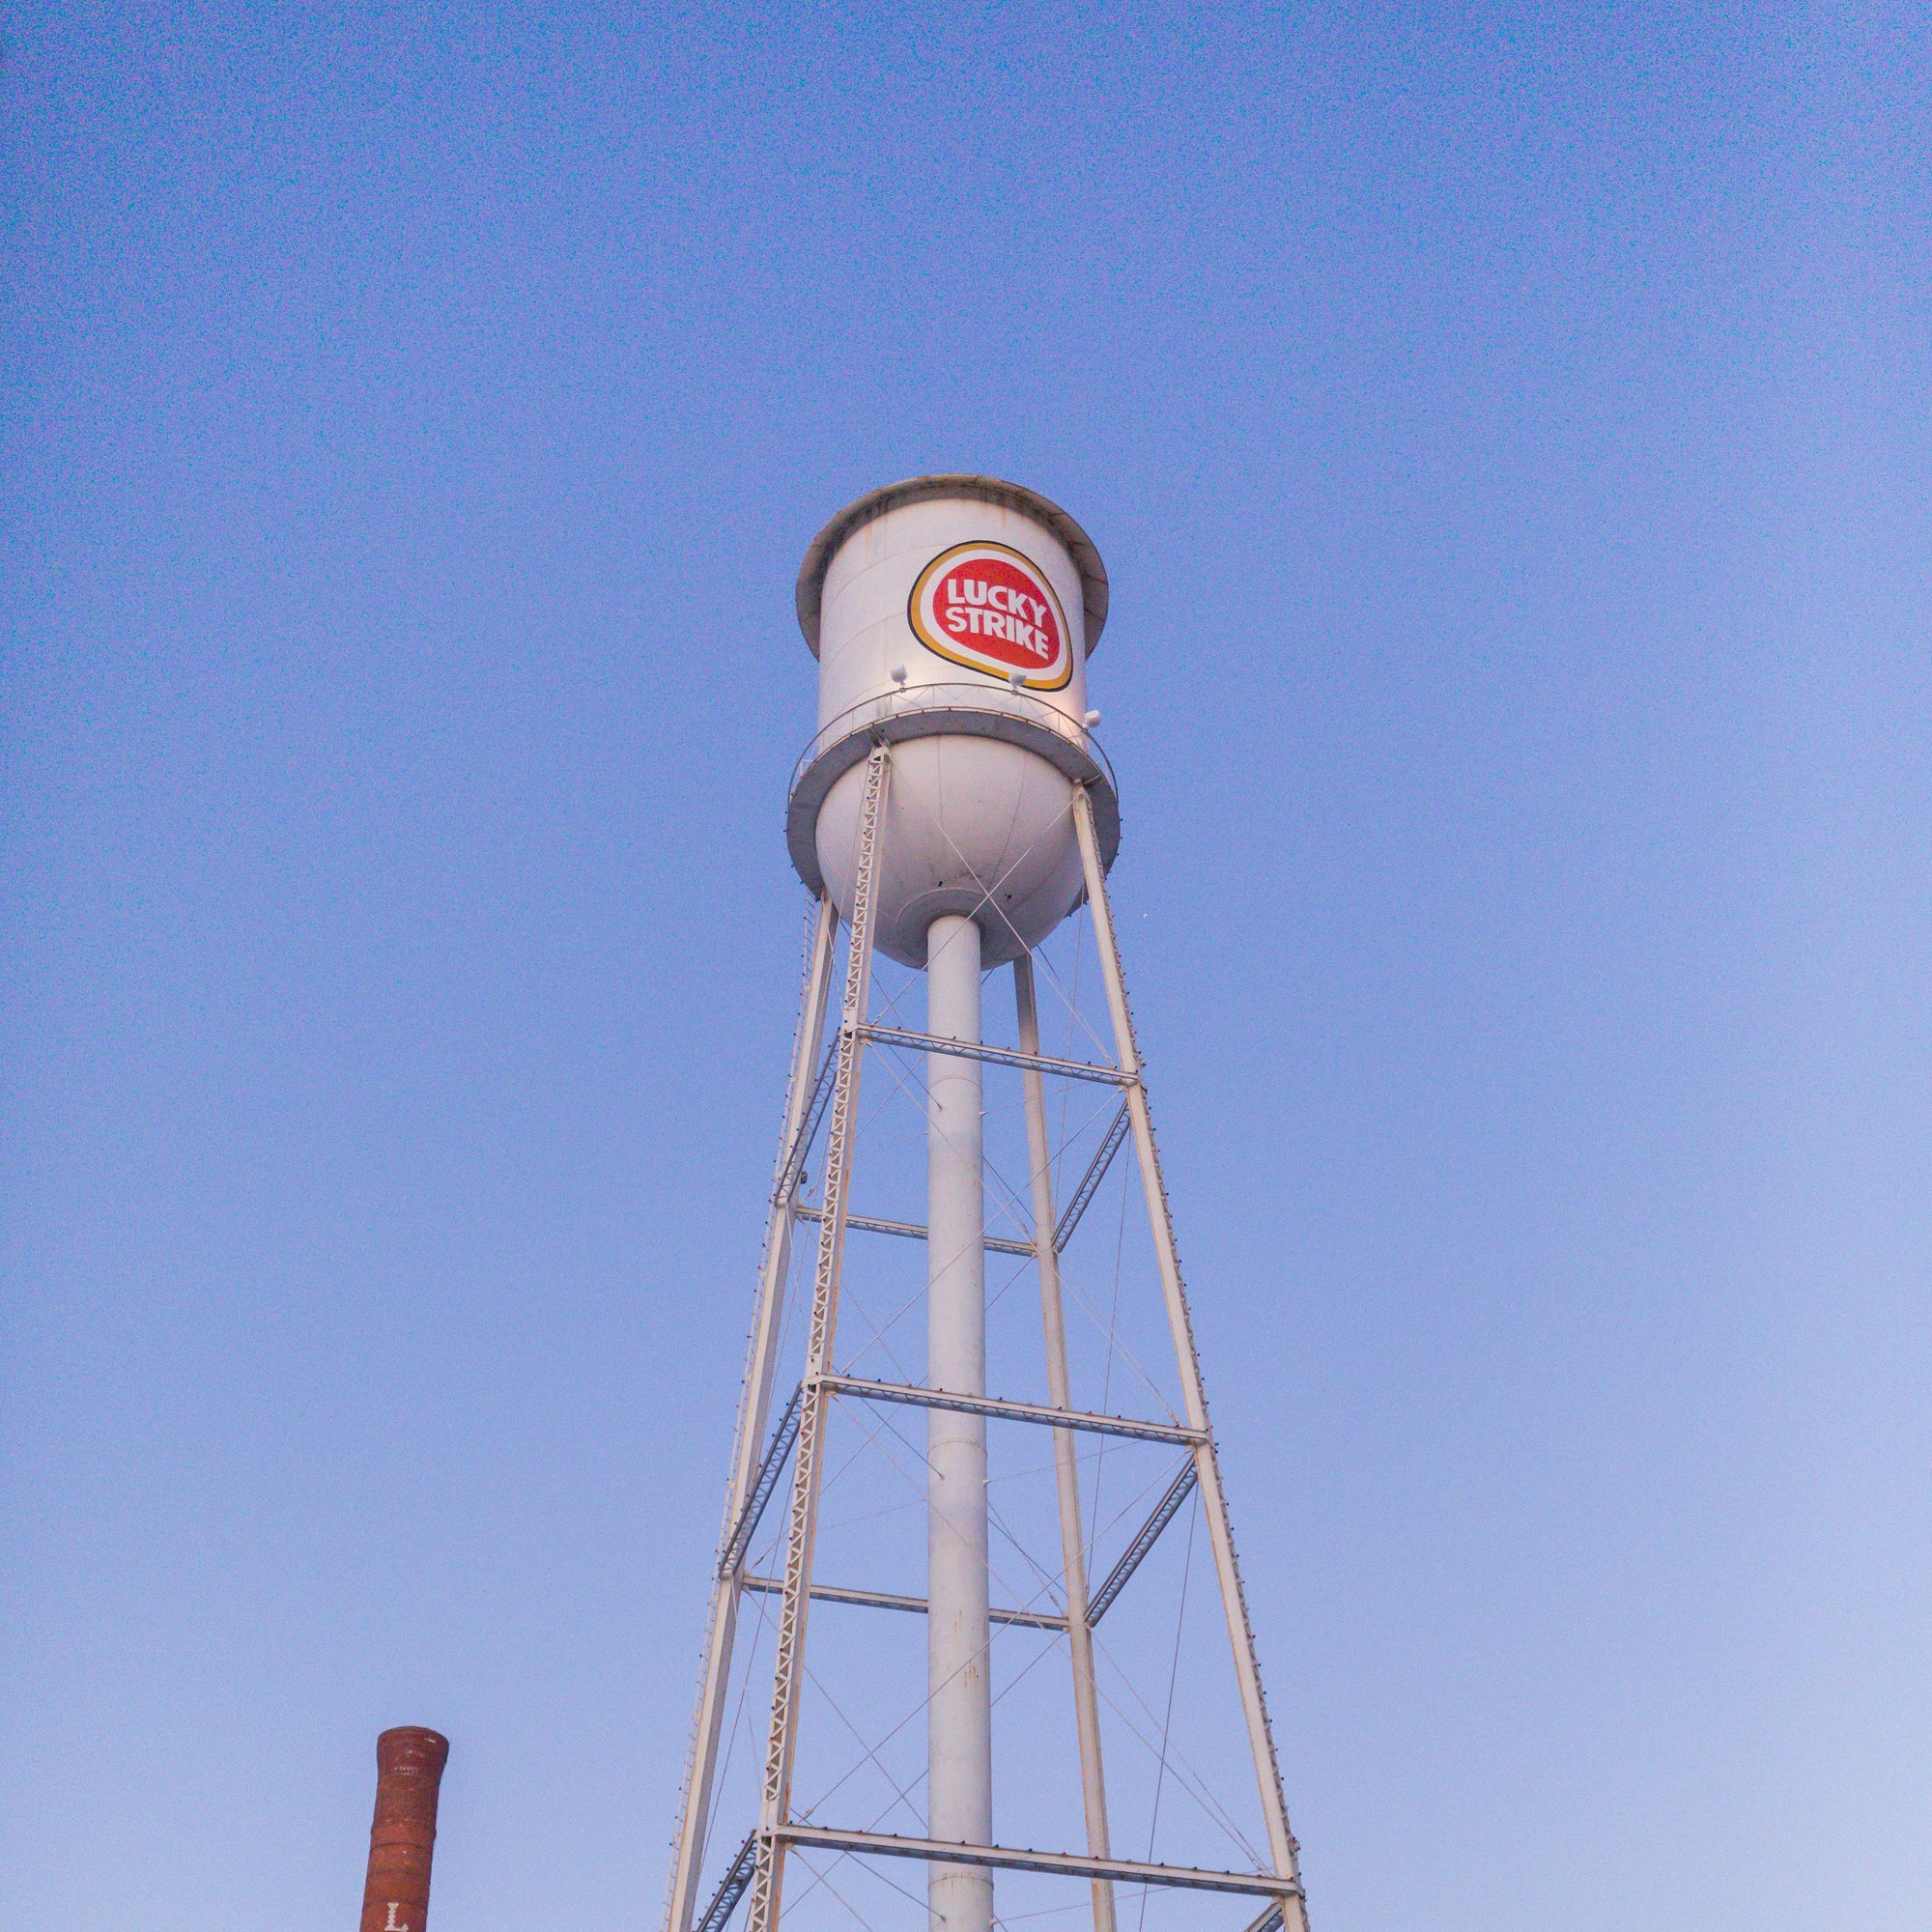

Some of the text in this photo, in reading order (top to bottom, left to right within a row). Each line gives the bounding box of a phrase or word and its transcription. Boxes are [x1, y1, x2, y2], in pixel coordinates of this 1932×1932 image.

[948, 579, 1046, 628] LUCKY
[946, 607, 1049, 660] STRIKE
[384, 1902, 409, 1932] L
